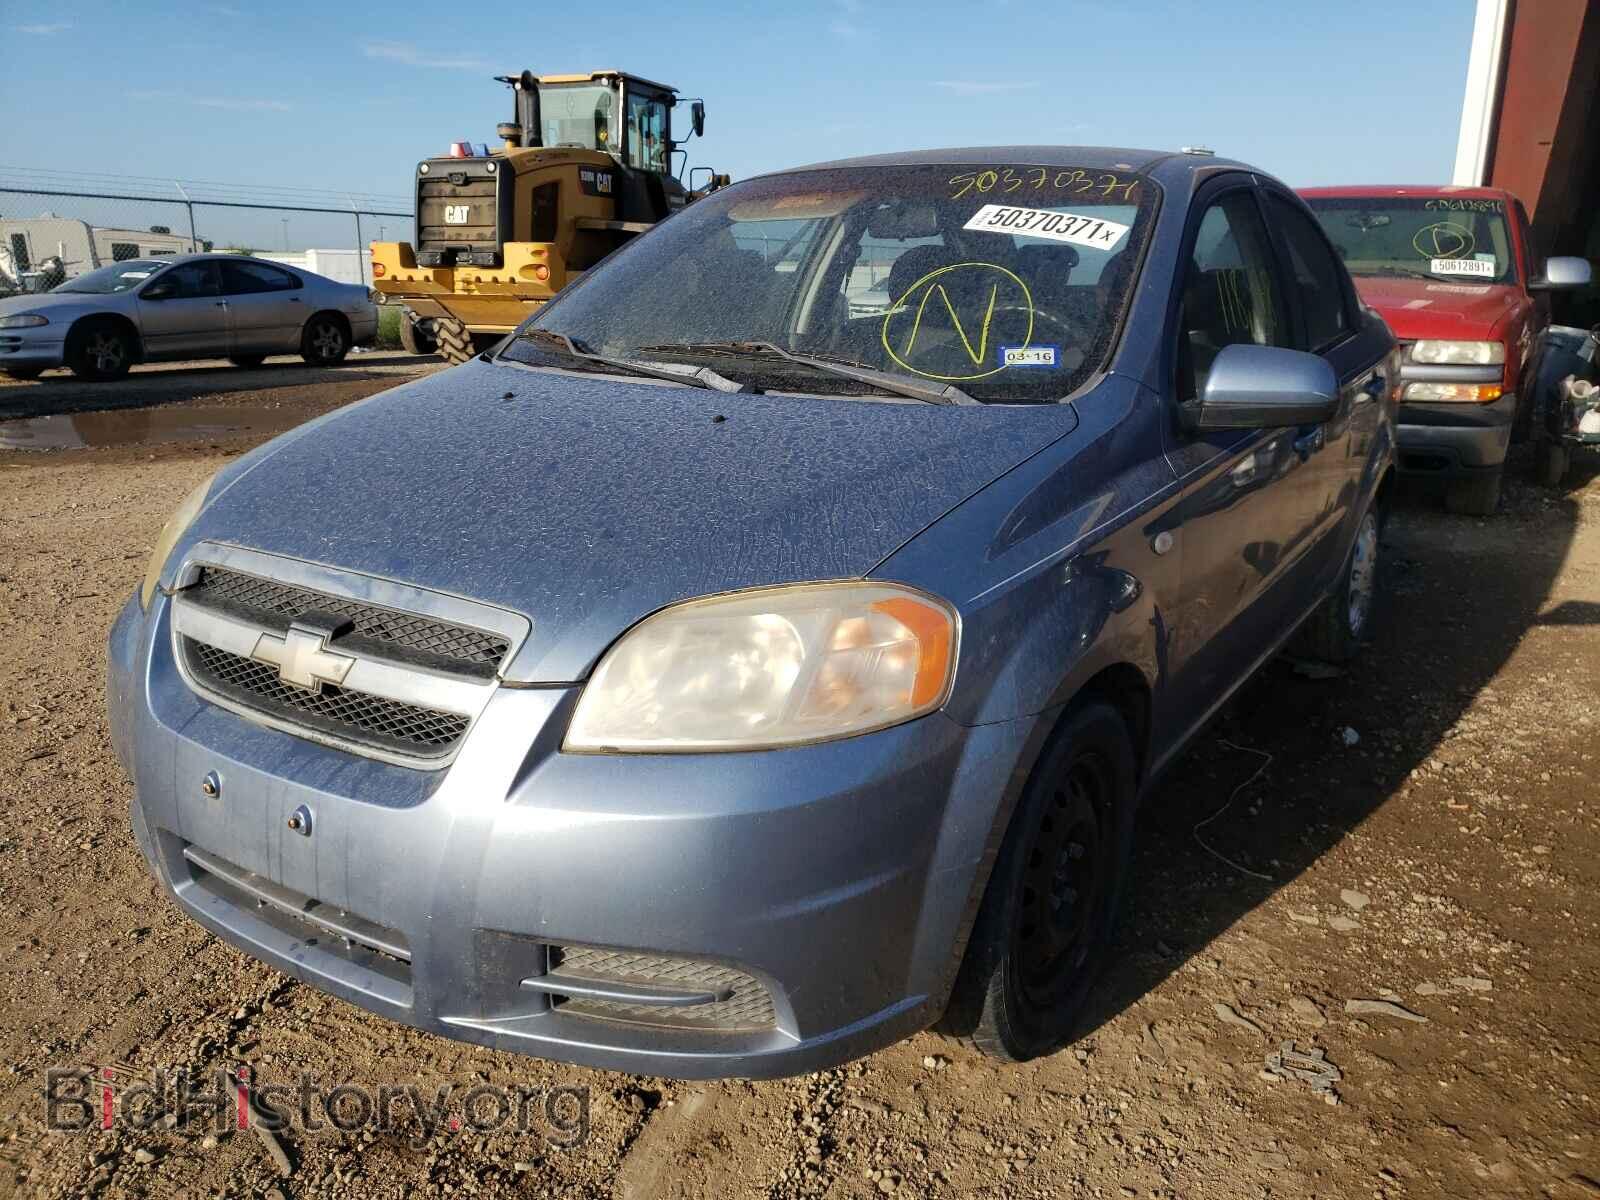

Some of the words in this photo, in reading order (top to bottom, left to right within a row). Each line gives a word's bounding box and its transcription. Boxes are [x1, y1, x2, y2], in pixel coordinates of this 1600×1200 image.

[597, 172, 612, 192] CAT
[949, 168, 1139, 200] 50370371
[445, 205, 470, 224] CAT
[905, 283, 997, 367] N
